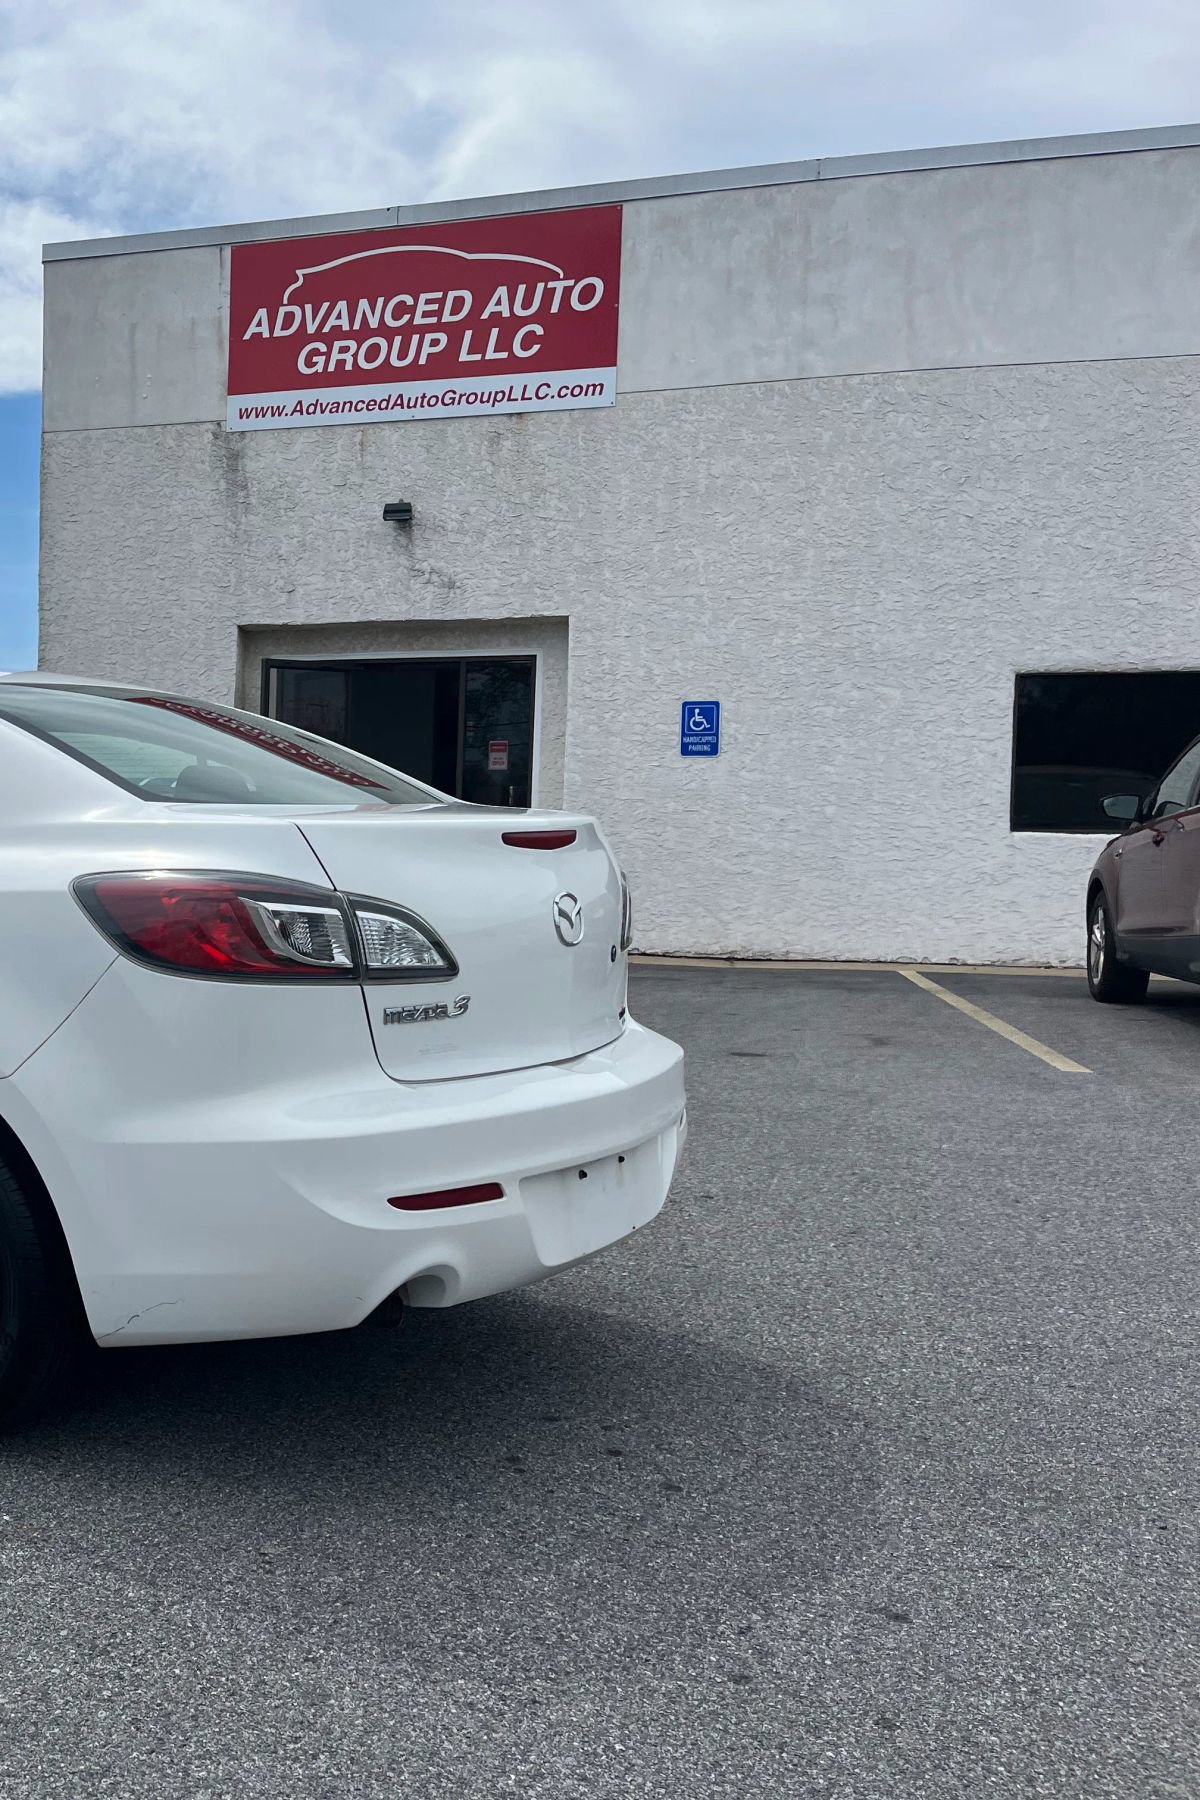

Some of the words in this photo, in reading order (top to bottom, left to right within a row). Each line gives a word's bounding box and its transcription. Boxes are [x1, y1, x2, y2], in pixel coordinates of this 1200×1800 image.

[242, 290, 473, 341] ADVANCED
[480, 276, 604, 320] AUTO
[297, 332, 448, 374] GROUP
[458, 323, 544, 362] LLC
[238, 380, 604, 420] www.AdvancedAutoGroupLLC.com
